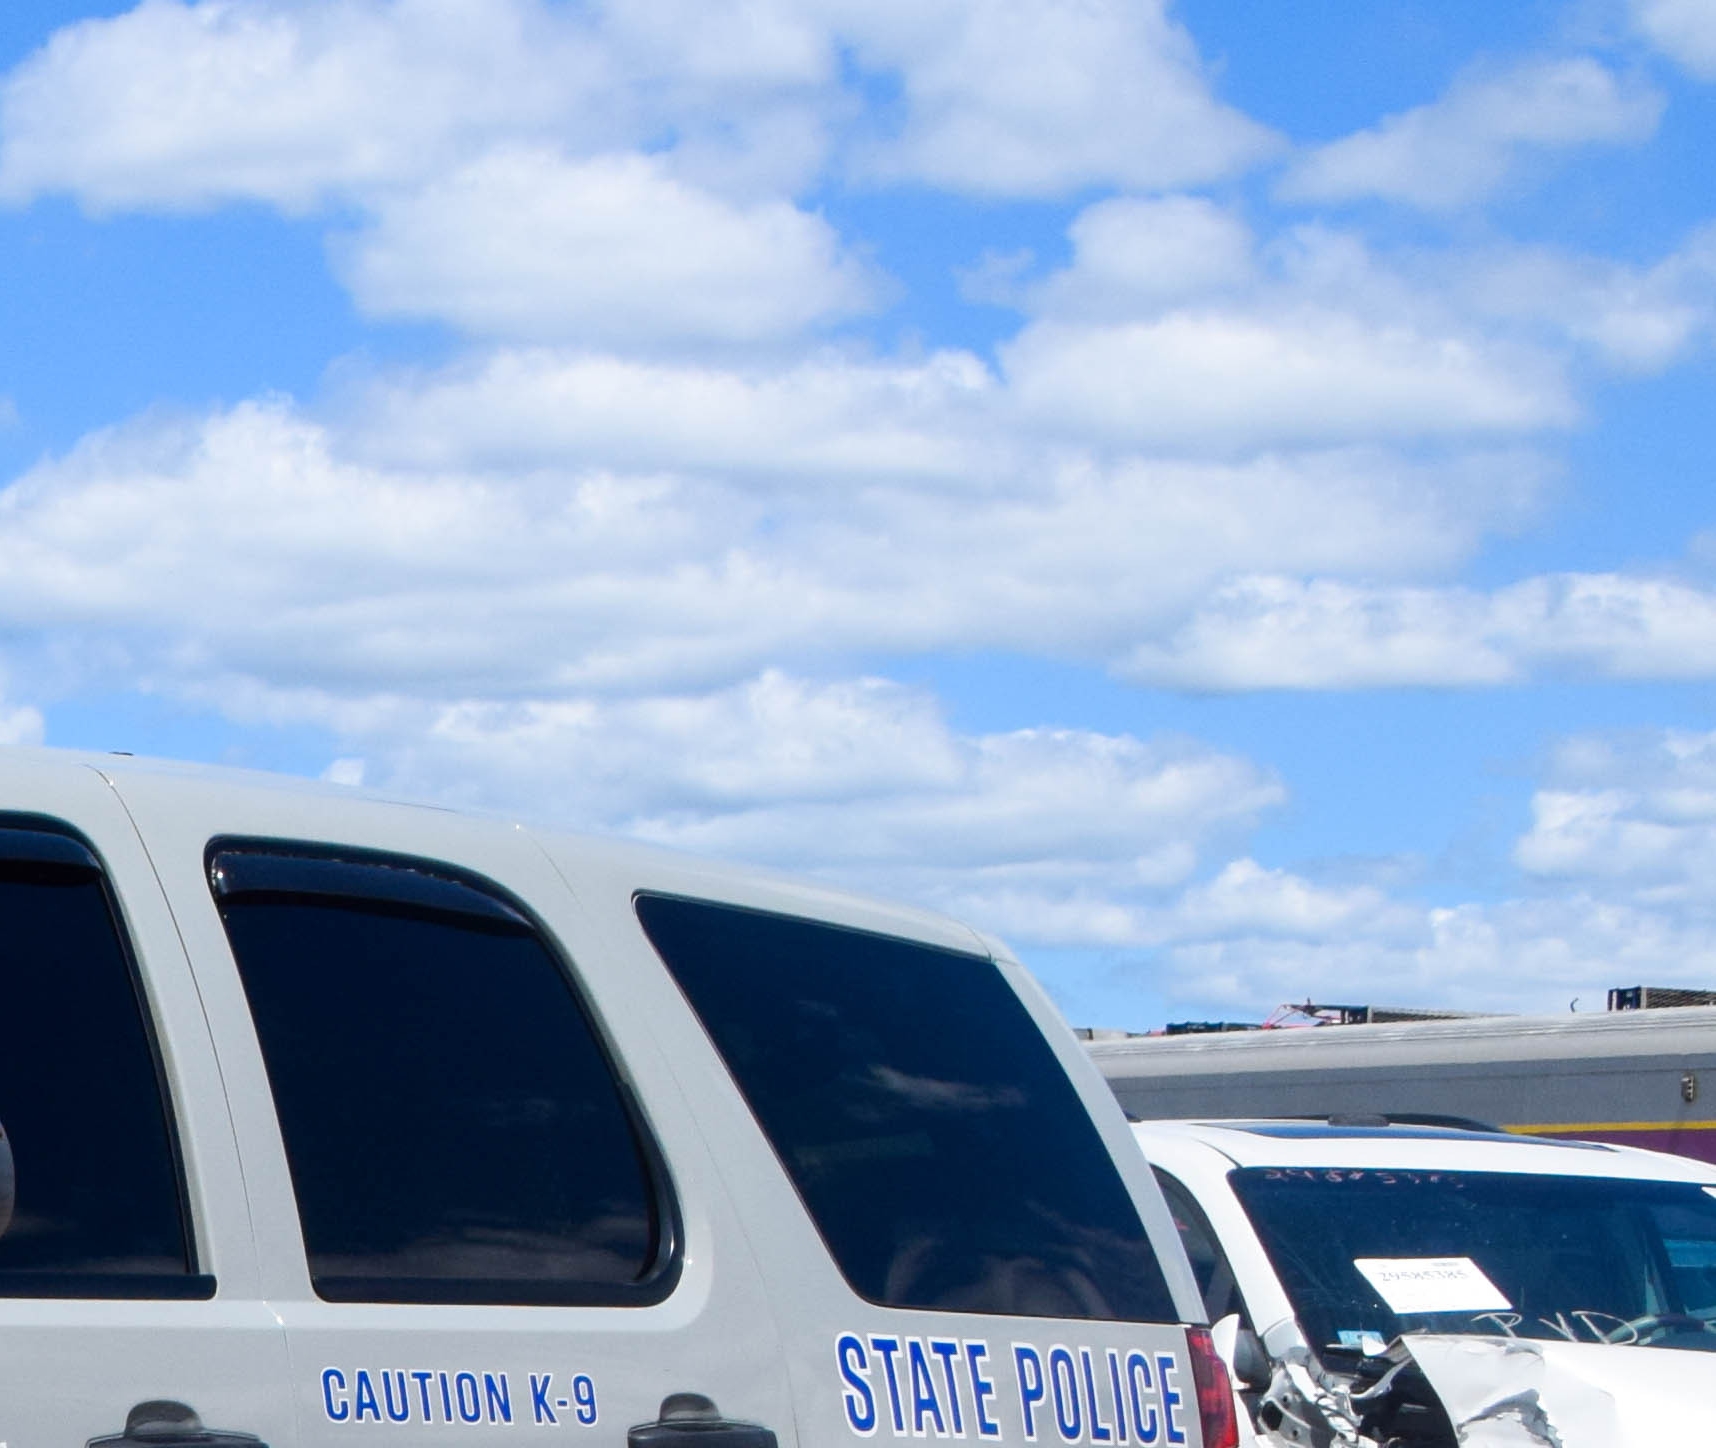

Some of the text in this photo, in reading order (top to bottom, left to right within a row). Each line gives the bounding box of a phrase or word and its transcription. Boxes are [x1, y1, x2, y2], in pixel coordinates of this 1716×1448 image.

[320, 1366, 599, 1427] CAUTION K-9
[834, 1330, 1189, 1448] STATE POLICE
